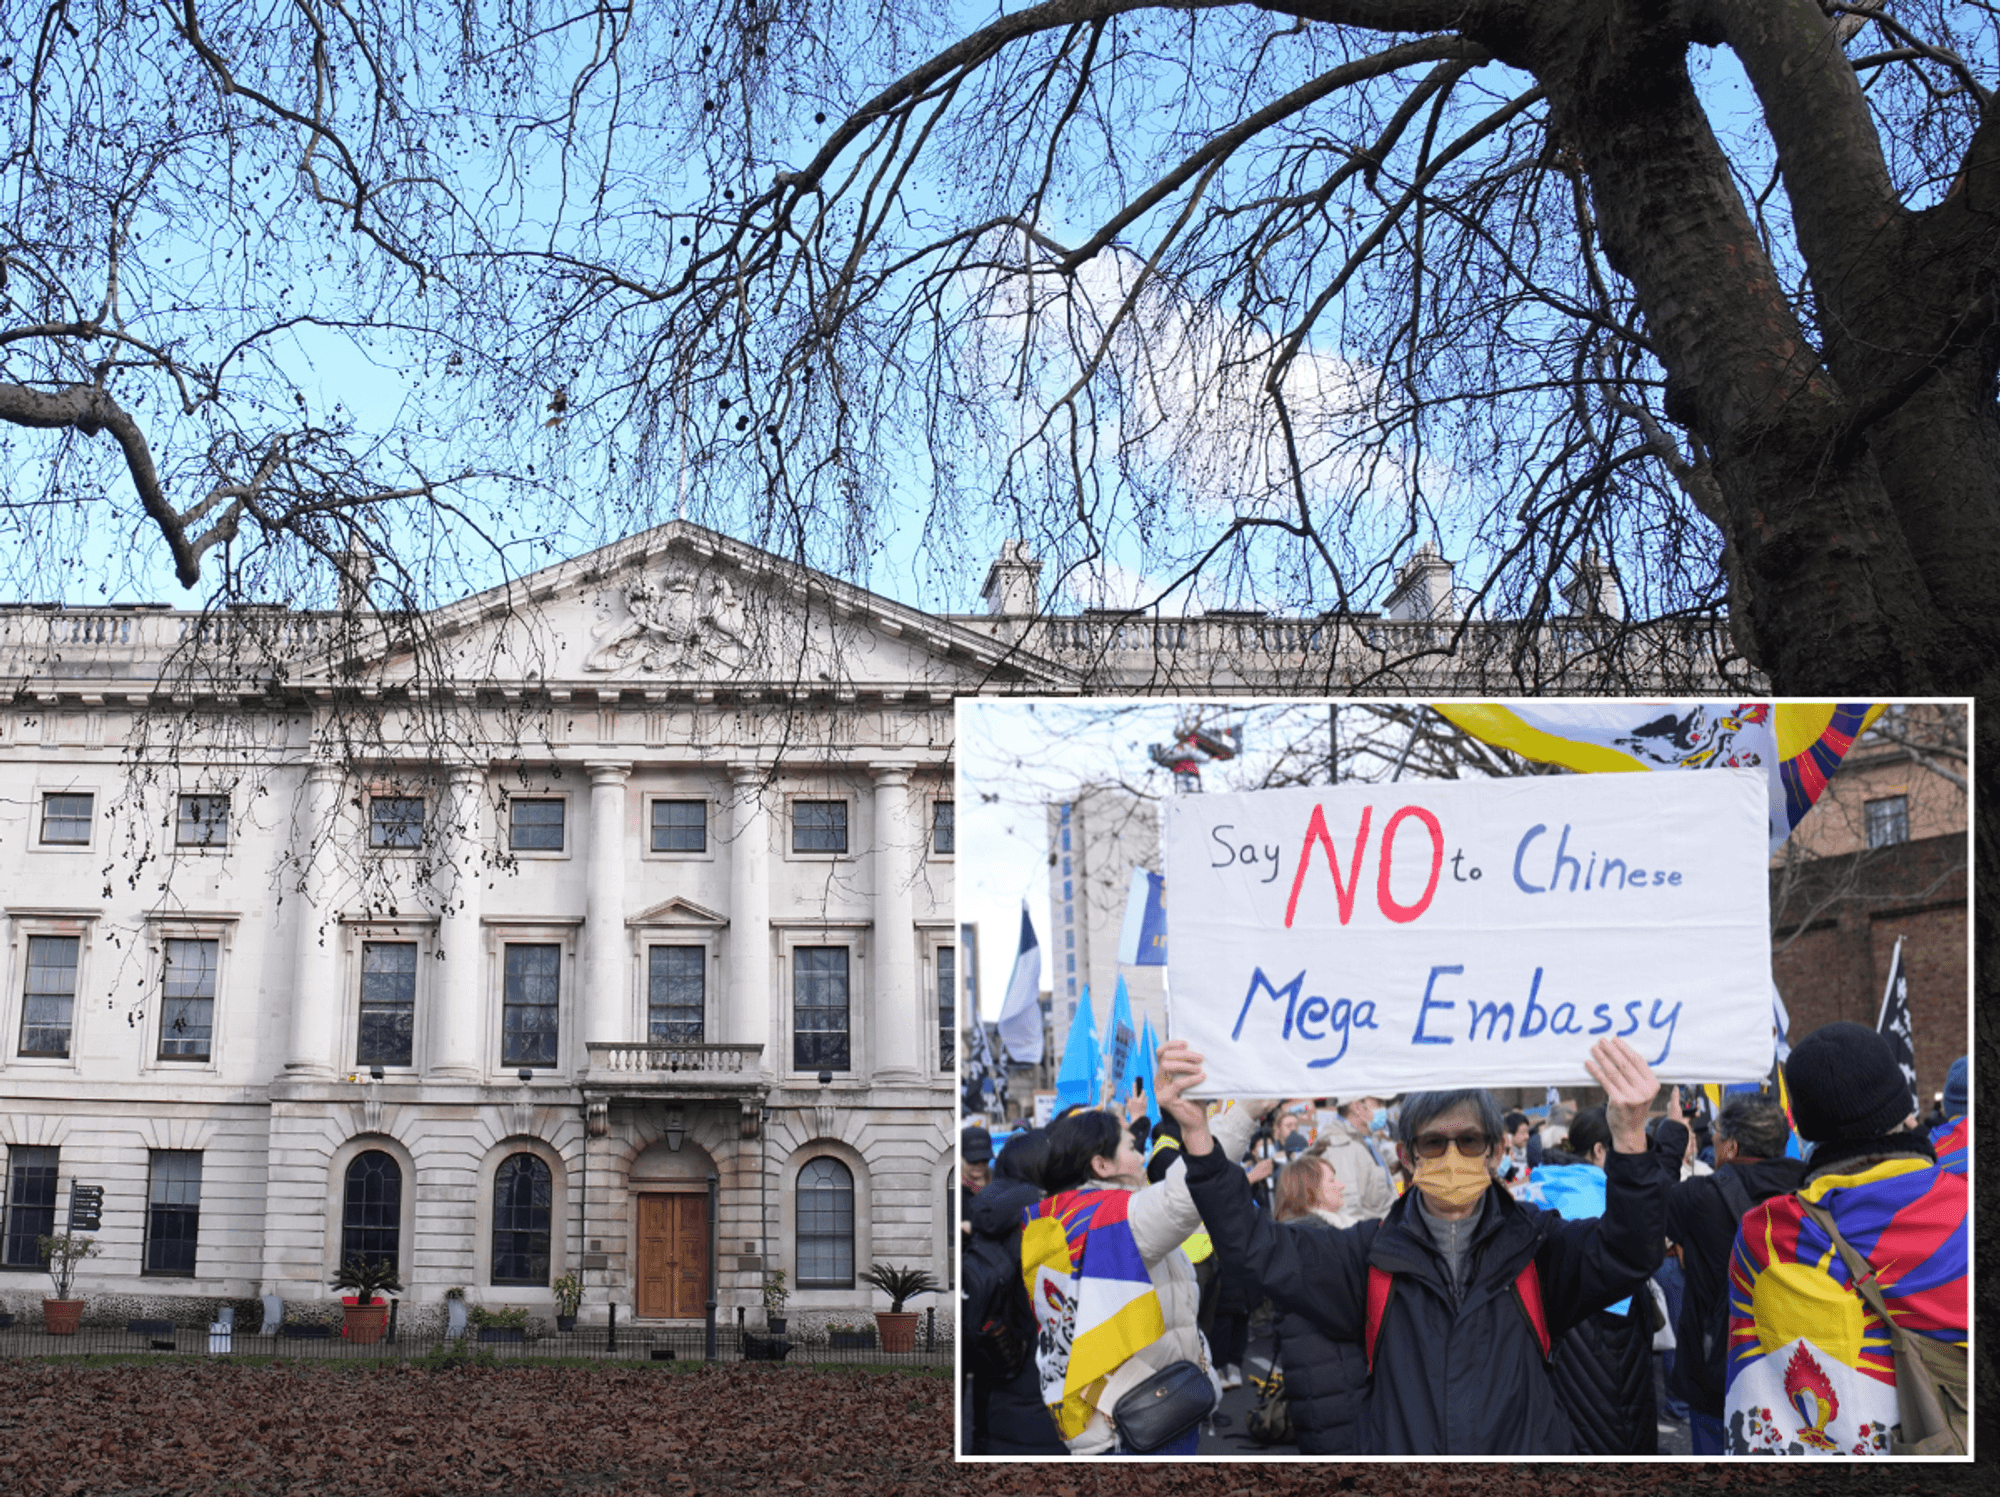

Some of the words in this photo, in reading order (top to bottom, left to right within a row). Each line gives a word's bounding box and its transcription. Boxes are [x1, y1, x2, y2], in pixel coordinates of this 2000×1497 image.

[1211, 824, 1280, 884] Say
[1284, 803, 1445, 929] NO
[1450, 848, 1483, 883] to
[1513, 823, 1683, 895] Chinese
[1231, 966, 1380, 1069] Mega
[1411, 964, 1683, 1068] Embassy
